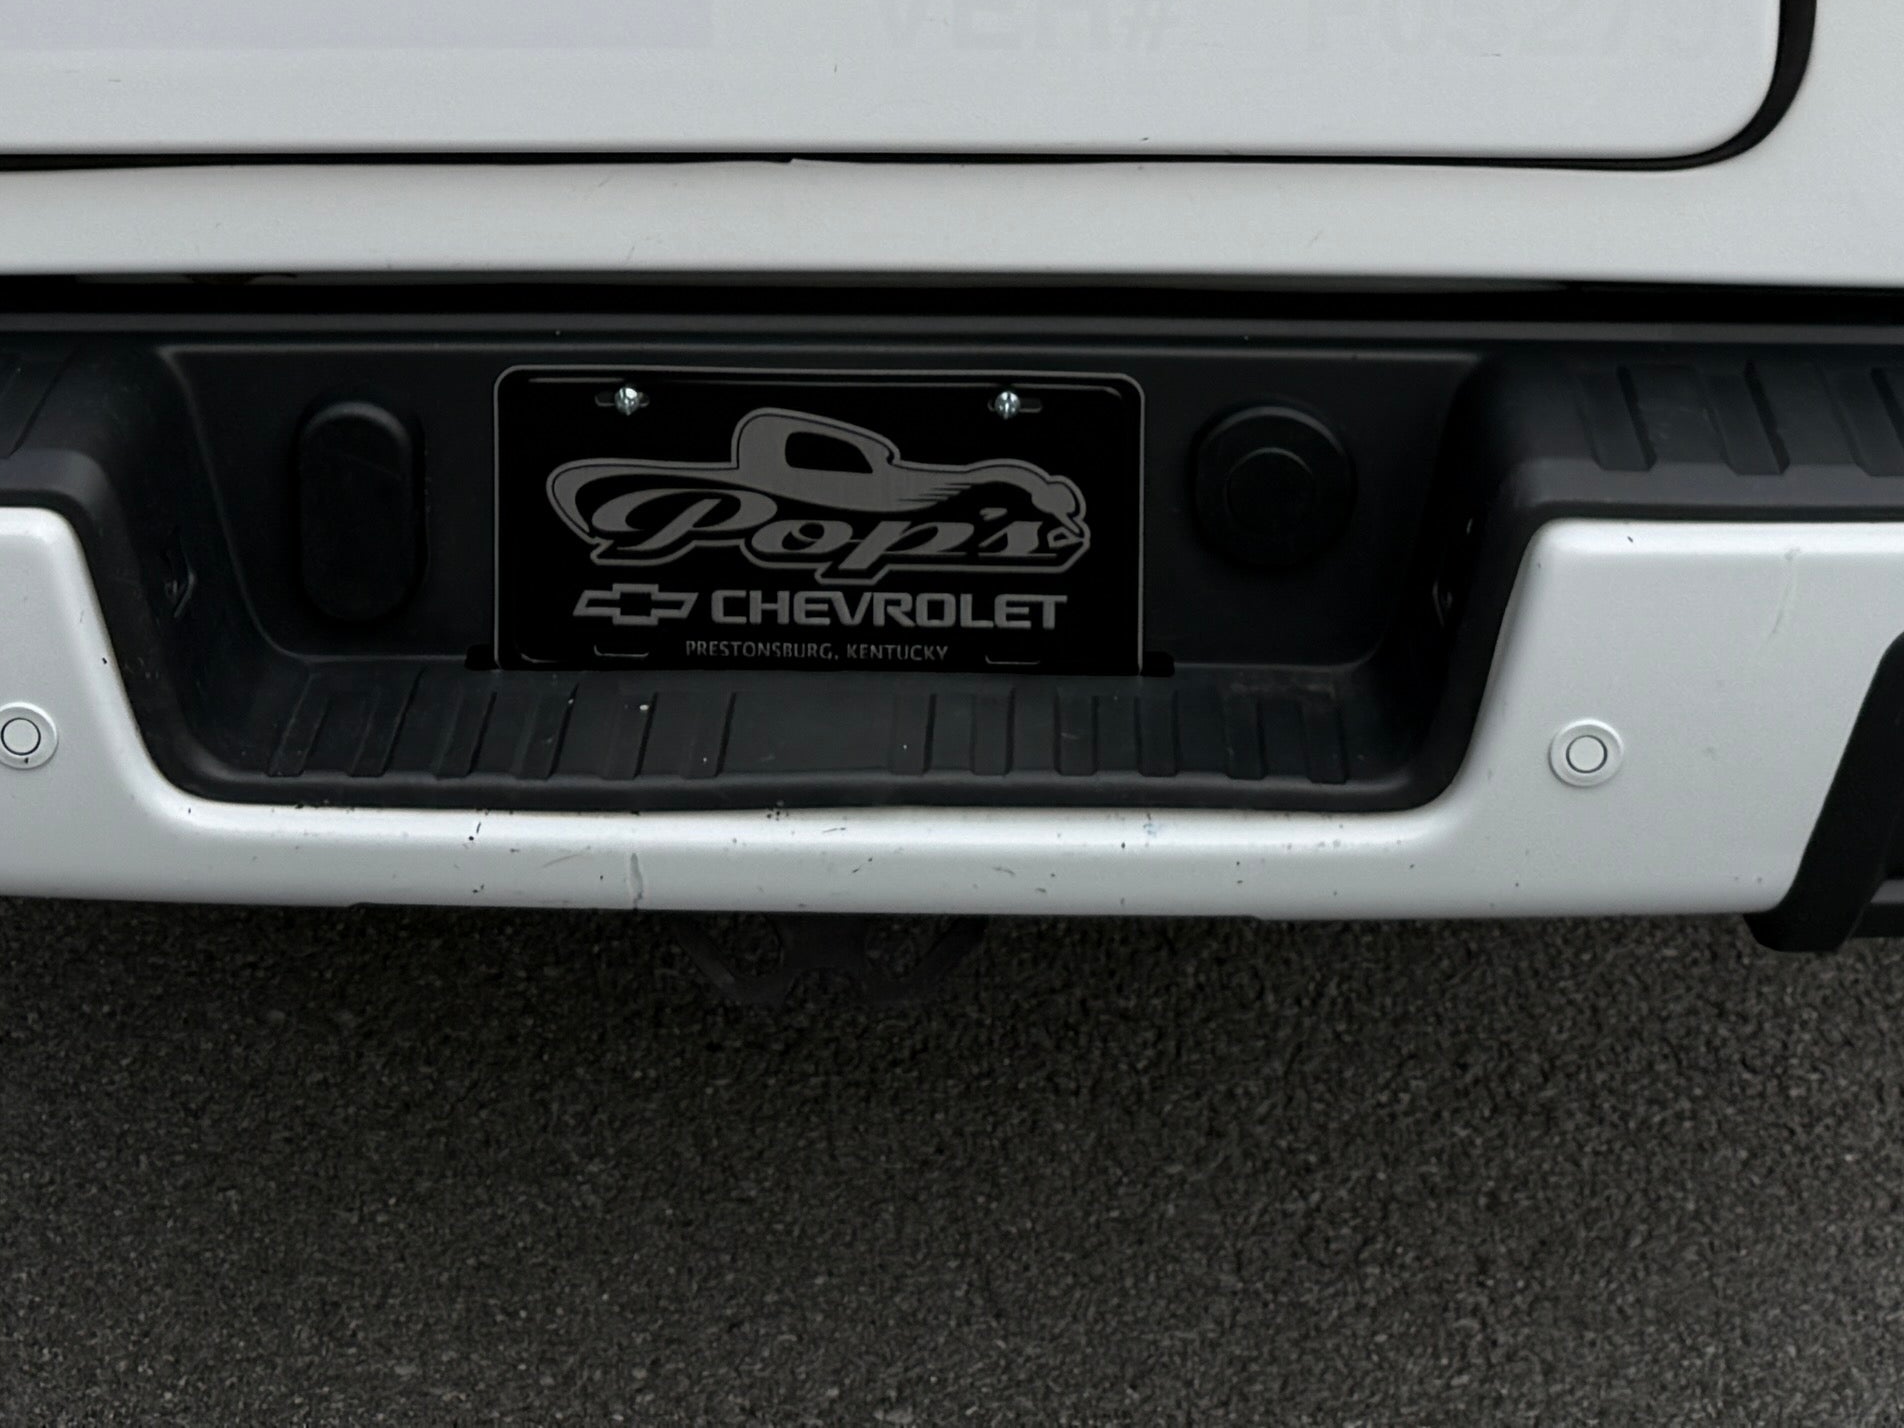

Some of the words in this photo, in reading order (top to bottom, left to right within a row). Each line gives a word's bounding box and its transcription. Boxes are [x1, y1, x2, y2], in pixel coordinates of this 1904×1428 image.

[710, 588, 1069, 630] CHEVROLET
[684, 639, 840, 662] PRESTONSBURG,
[846, 643, 949, 662] KENTUCKY
